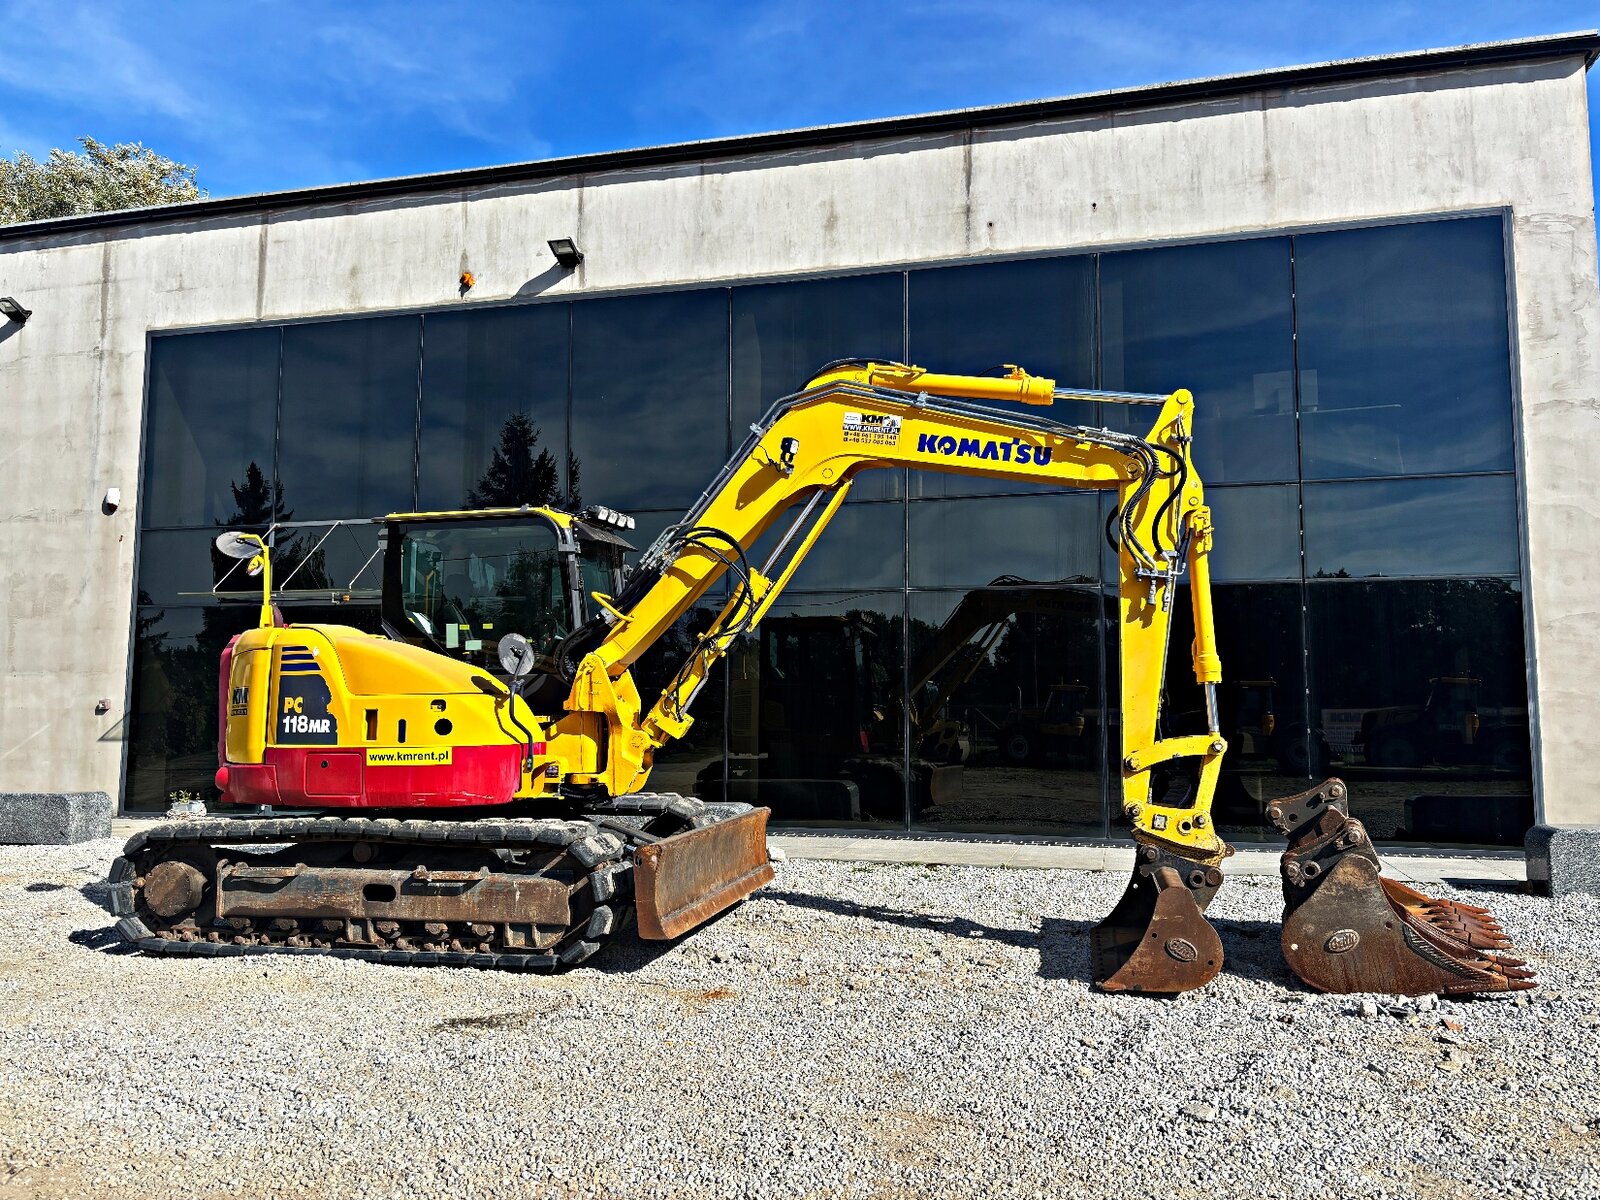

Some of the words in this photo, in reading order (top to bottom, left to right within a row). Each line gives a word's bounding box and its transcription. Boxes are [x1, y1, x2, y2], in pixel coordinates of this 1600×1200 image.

[861, 414, 884, 423] KM
[917, 433, 1053, 466] KOMATSU
[283, 696, 304, 714] PC
[369, 751, 449, 762] www.kmrent.pl
